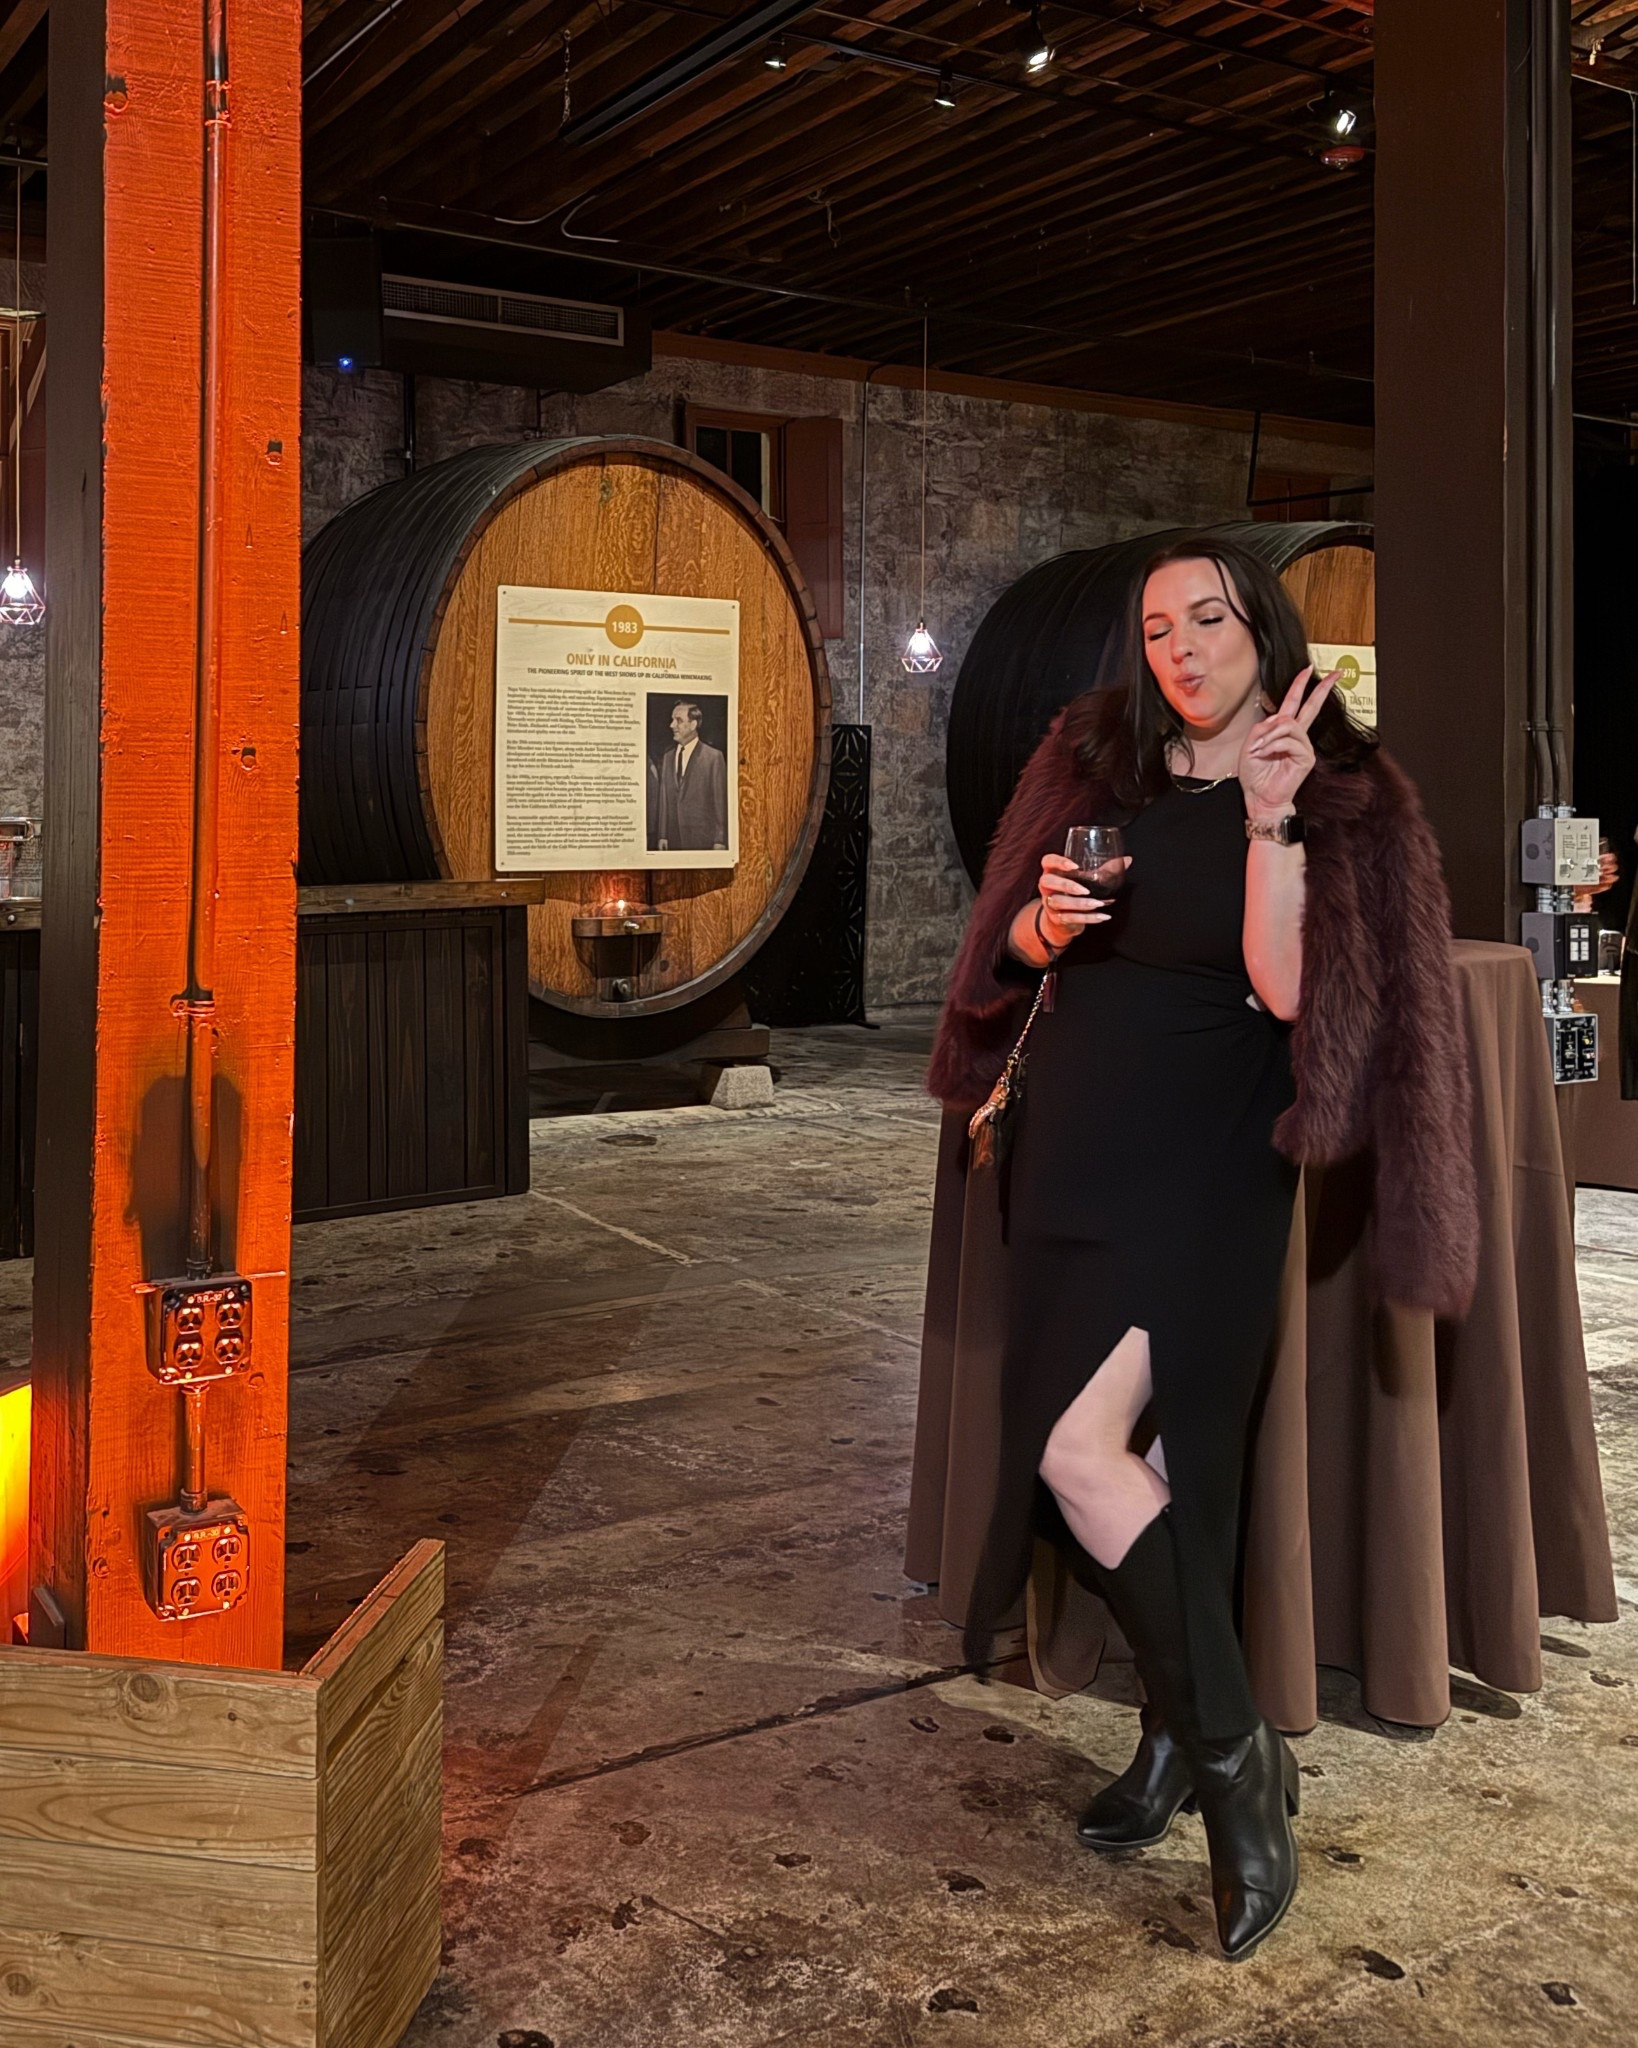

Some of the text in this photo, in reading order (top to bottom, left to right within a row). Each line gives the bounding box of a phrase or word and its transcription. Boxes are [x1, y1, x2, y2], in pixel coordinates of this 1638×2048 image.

[611, 621, 638, 634] 1983
[566, 653, 677, 669] ONLY IN CALIFORNIA
